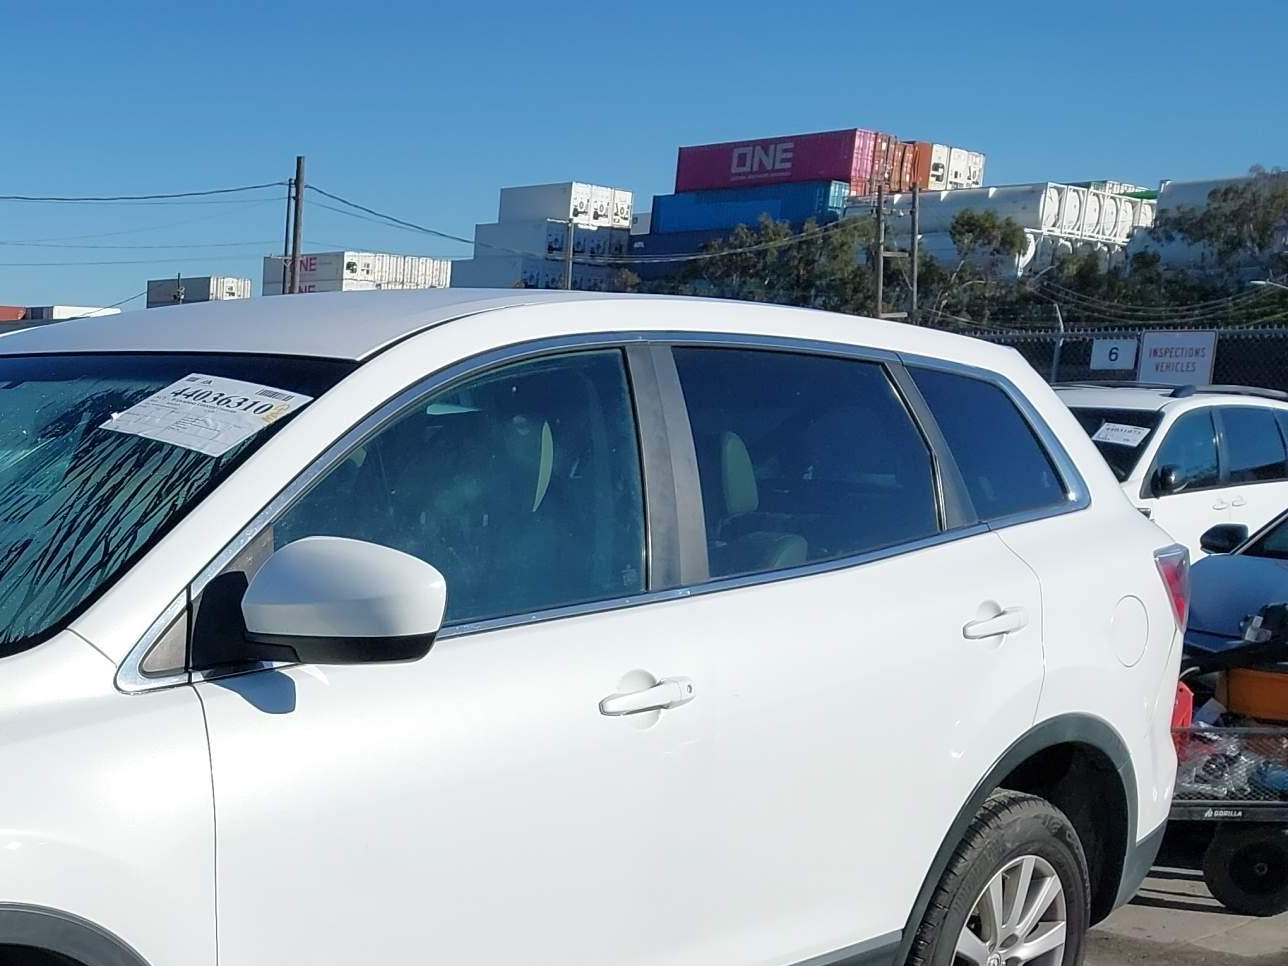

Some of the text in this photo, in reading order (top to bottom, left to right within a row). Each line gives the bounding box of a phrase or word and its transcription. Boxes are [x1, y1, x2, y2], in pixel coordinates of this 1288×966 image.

[731, 142, 794, 174] ONE
[1107, 346, 1120, 362] 6
[1148, 346, 1206, 359] INSPECTIONS
[1154, 361, 1197, 373] VEHICLES
[170, 386, 274, 415] 44036310
[1213, 810, 1243, 818] GORILLA
